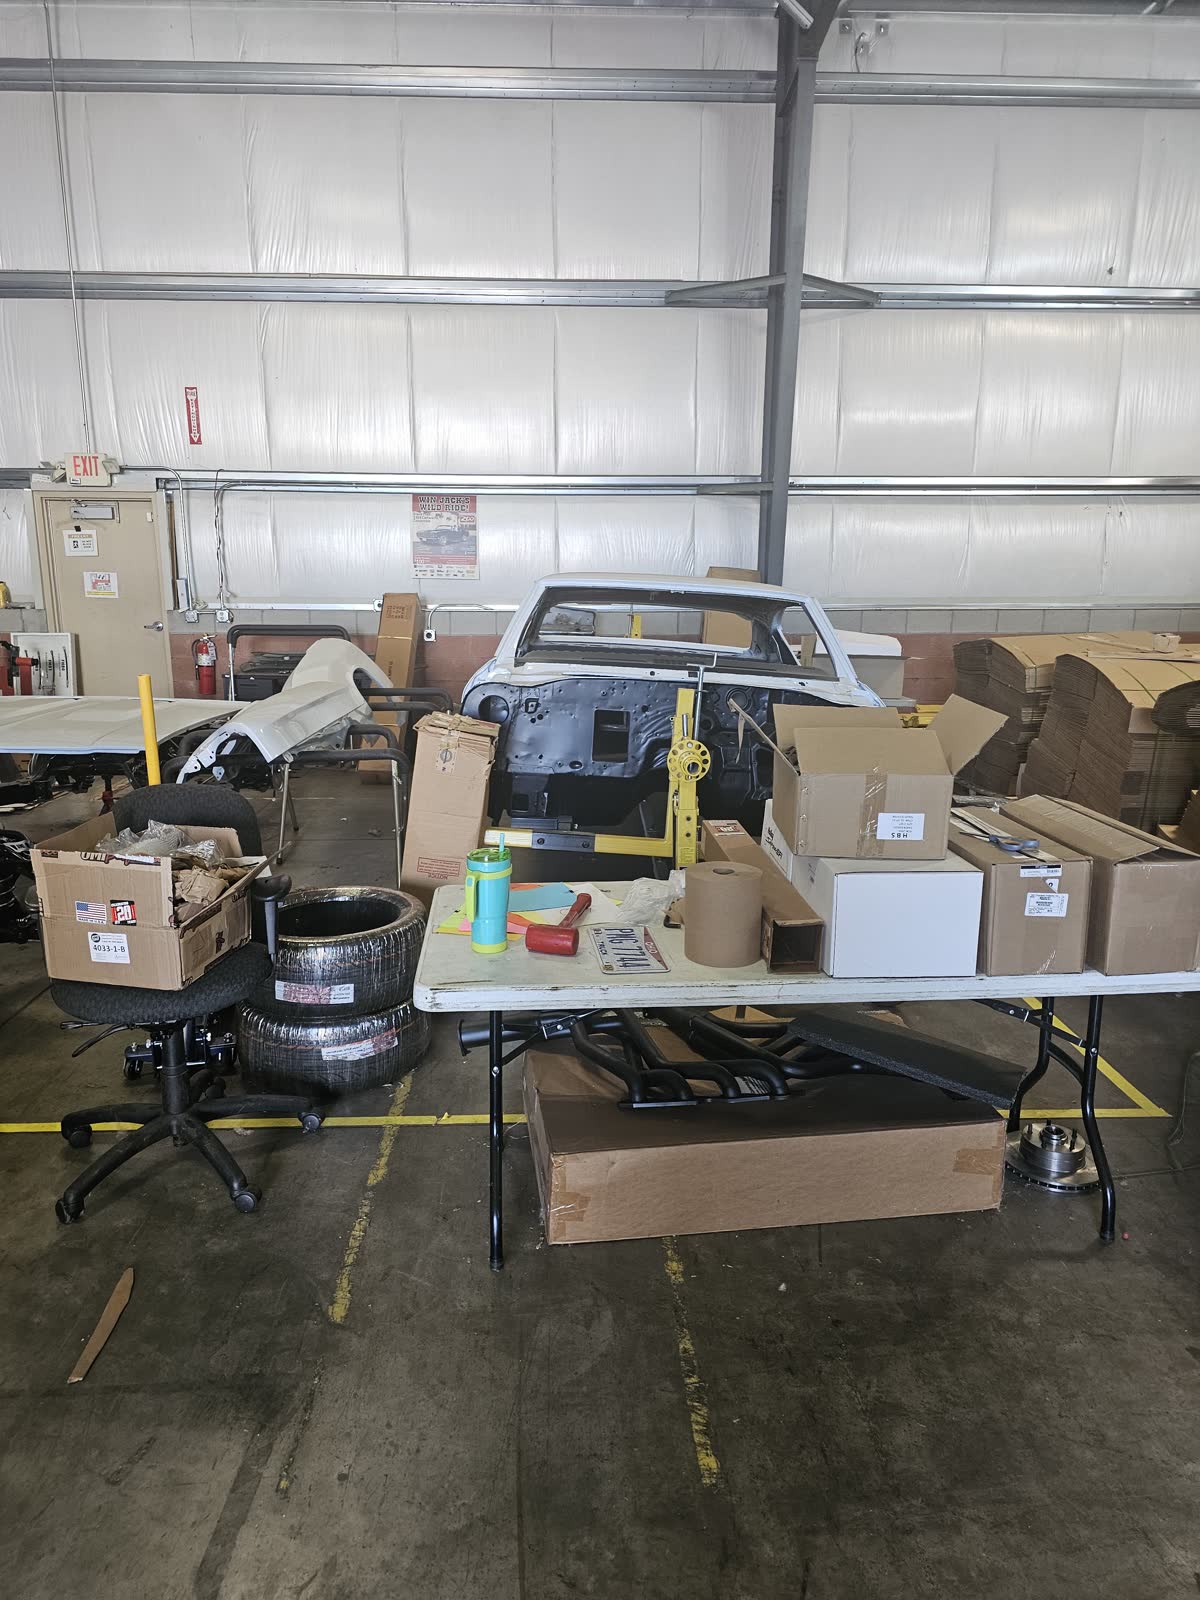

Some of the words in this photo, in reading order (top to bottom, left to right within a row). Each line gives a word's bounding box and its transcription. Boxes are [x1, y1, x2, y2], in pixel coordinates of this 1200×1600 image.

[73, 456, 98, 476] EXIT
[419, 496, 437, 504] WIN
[440, 496, 470, 504] JACK'S
[420, 503, 443, 511] WILD
[445, 504, 469, 512] RIDE!
[116, 905, 132, 921] 20
[93, 944, 126, 953] 4033-1-B
[611, 945, 651, 968] 7744
